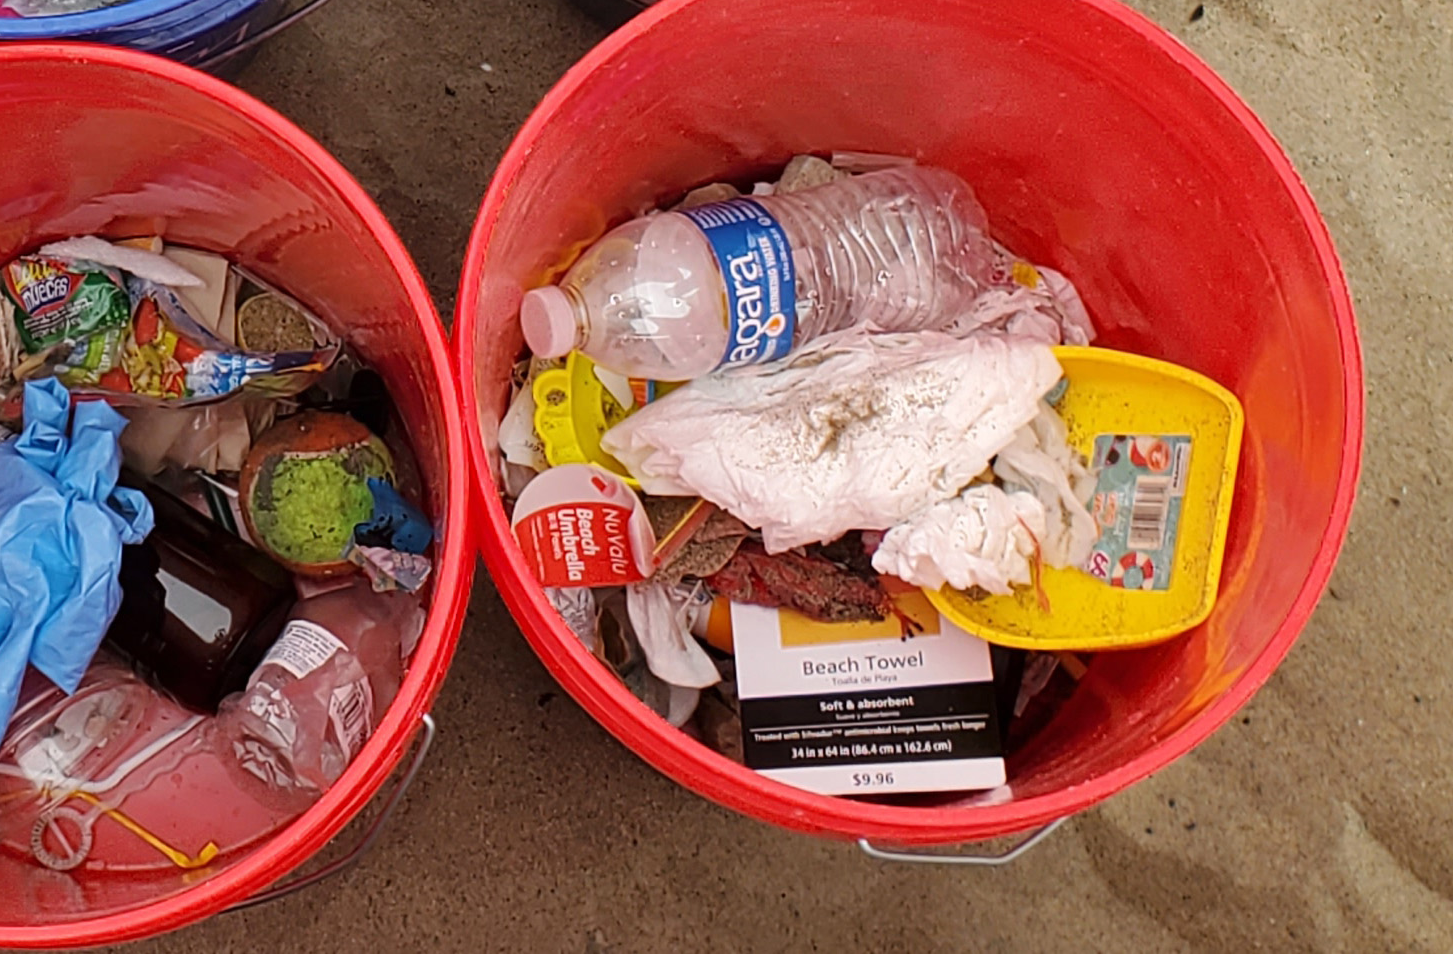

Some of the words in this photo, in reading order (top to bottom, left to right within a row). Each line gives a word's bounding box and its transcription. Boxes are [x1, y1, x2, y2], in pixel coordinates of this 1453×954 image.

[576, 507, 600, 556] Beach
[558, 508, 585, 582] Umbrella
[803, 656, 859, 676] Beach
[865, 650, 924, 671] Towel
[832, 676, 858, 686] Toalla
[861, 675, 872, 684] de
[875, 673, 897, 684] Playa
[819, 699, 844, 712] Soft
[846, 699, 854, 711] &
[857, 696, 915, 710] absorbent
[754, 732, 782, 742] Treated
[783, 731, 800, 740] with
[791, 747, 804, 759] 34
[806, 746, 816, 758] in
[817, 749, 824, 758] x
[825, 745, 838, 757] 64
[839, 745, 850, 756] in
[851, 743, 877, 757] (86.4
[879, 745, 894, 755] cm
[896, 745, 902, 754] x
[903, 741, 932, 754] 162.6
[933, 739, 953, 753] cm)
[853, 772, 894, 787] $9.96
